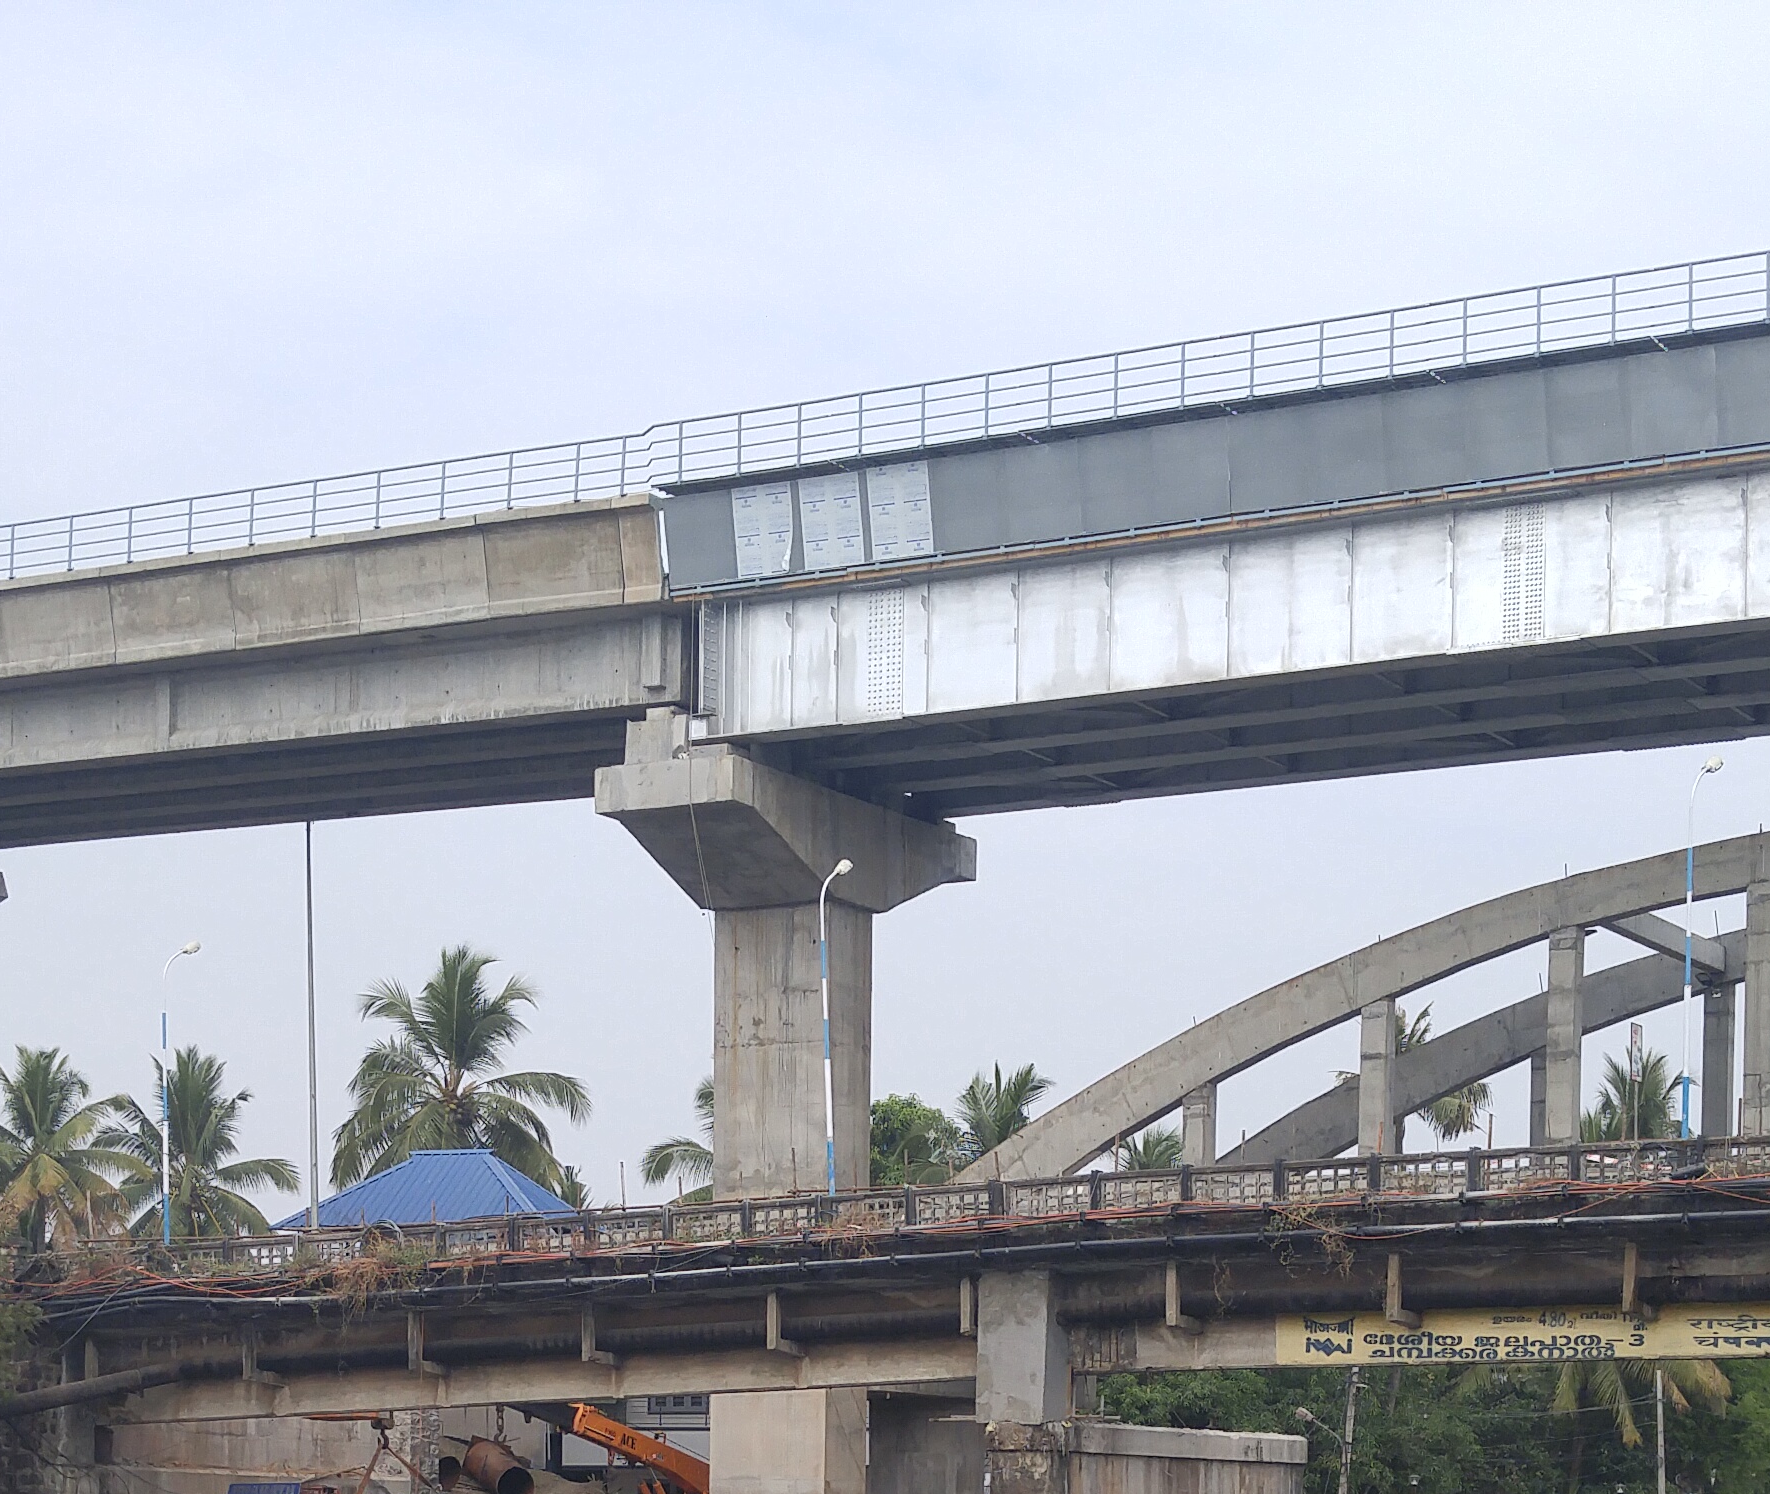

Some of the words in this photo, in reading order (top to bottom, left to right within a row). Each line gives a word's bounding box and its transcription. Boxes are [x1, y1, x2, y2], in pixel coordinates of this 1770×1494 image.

[1363, 1331, 1463, 1347] ദേശീയ
[1474, 1334, 1602, 1348] ജലപാത
[1629, 1333, 1645, 1347] 3
[1505, 1342, 1616, 1360] കനാൽ
